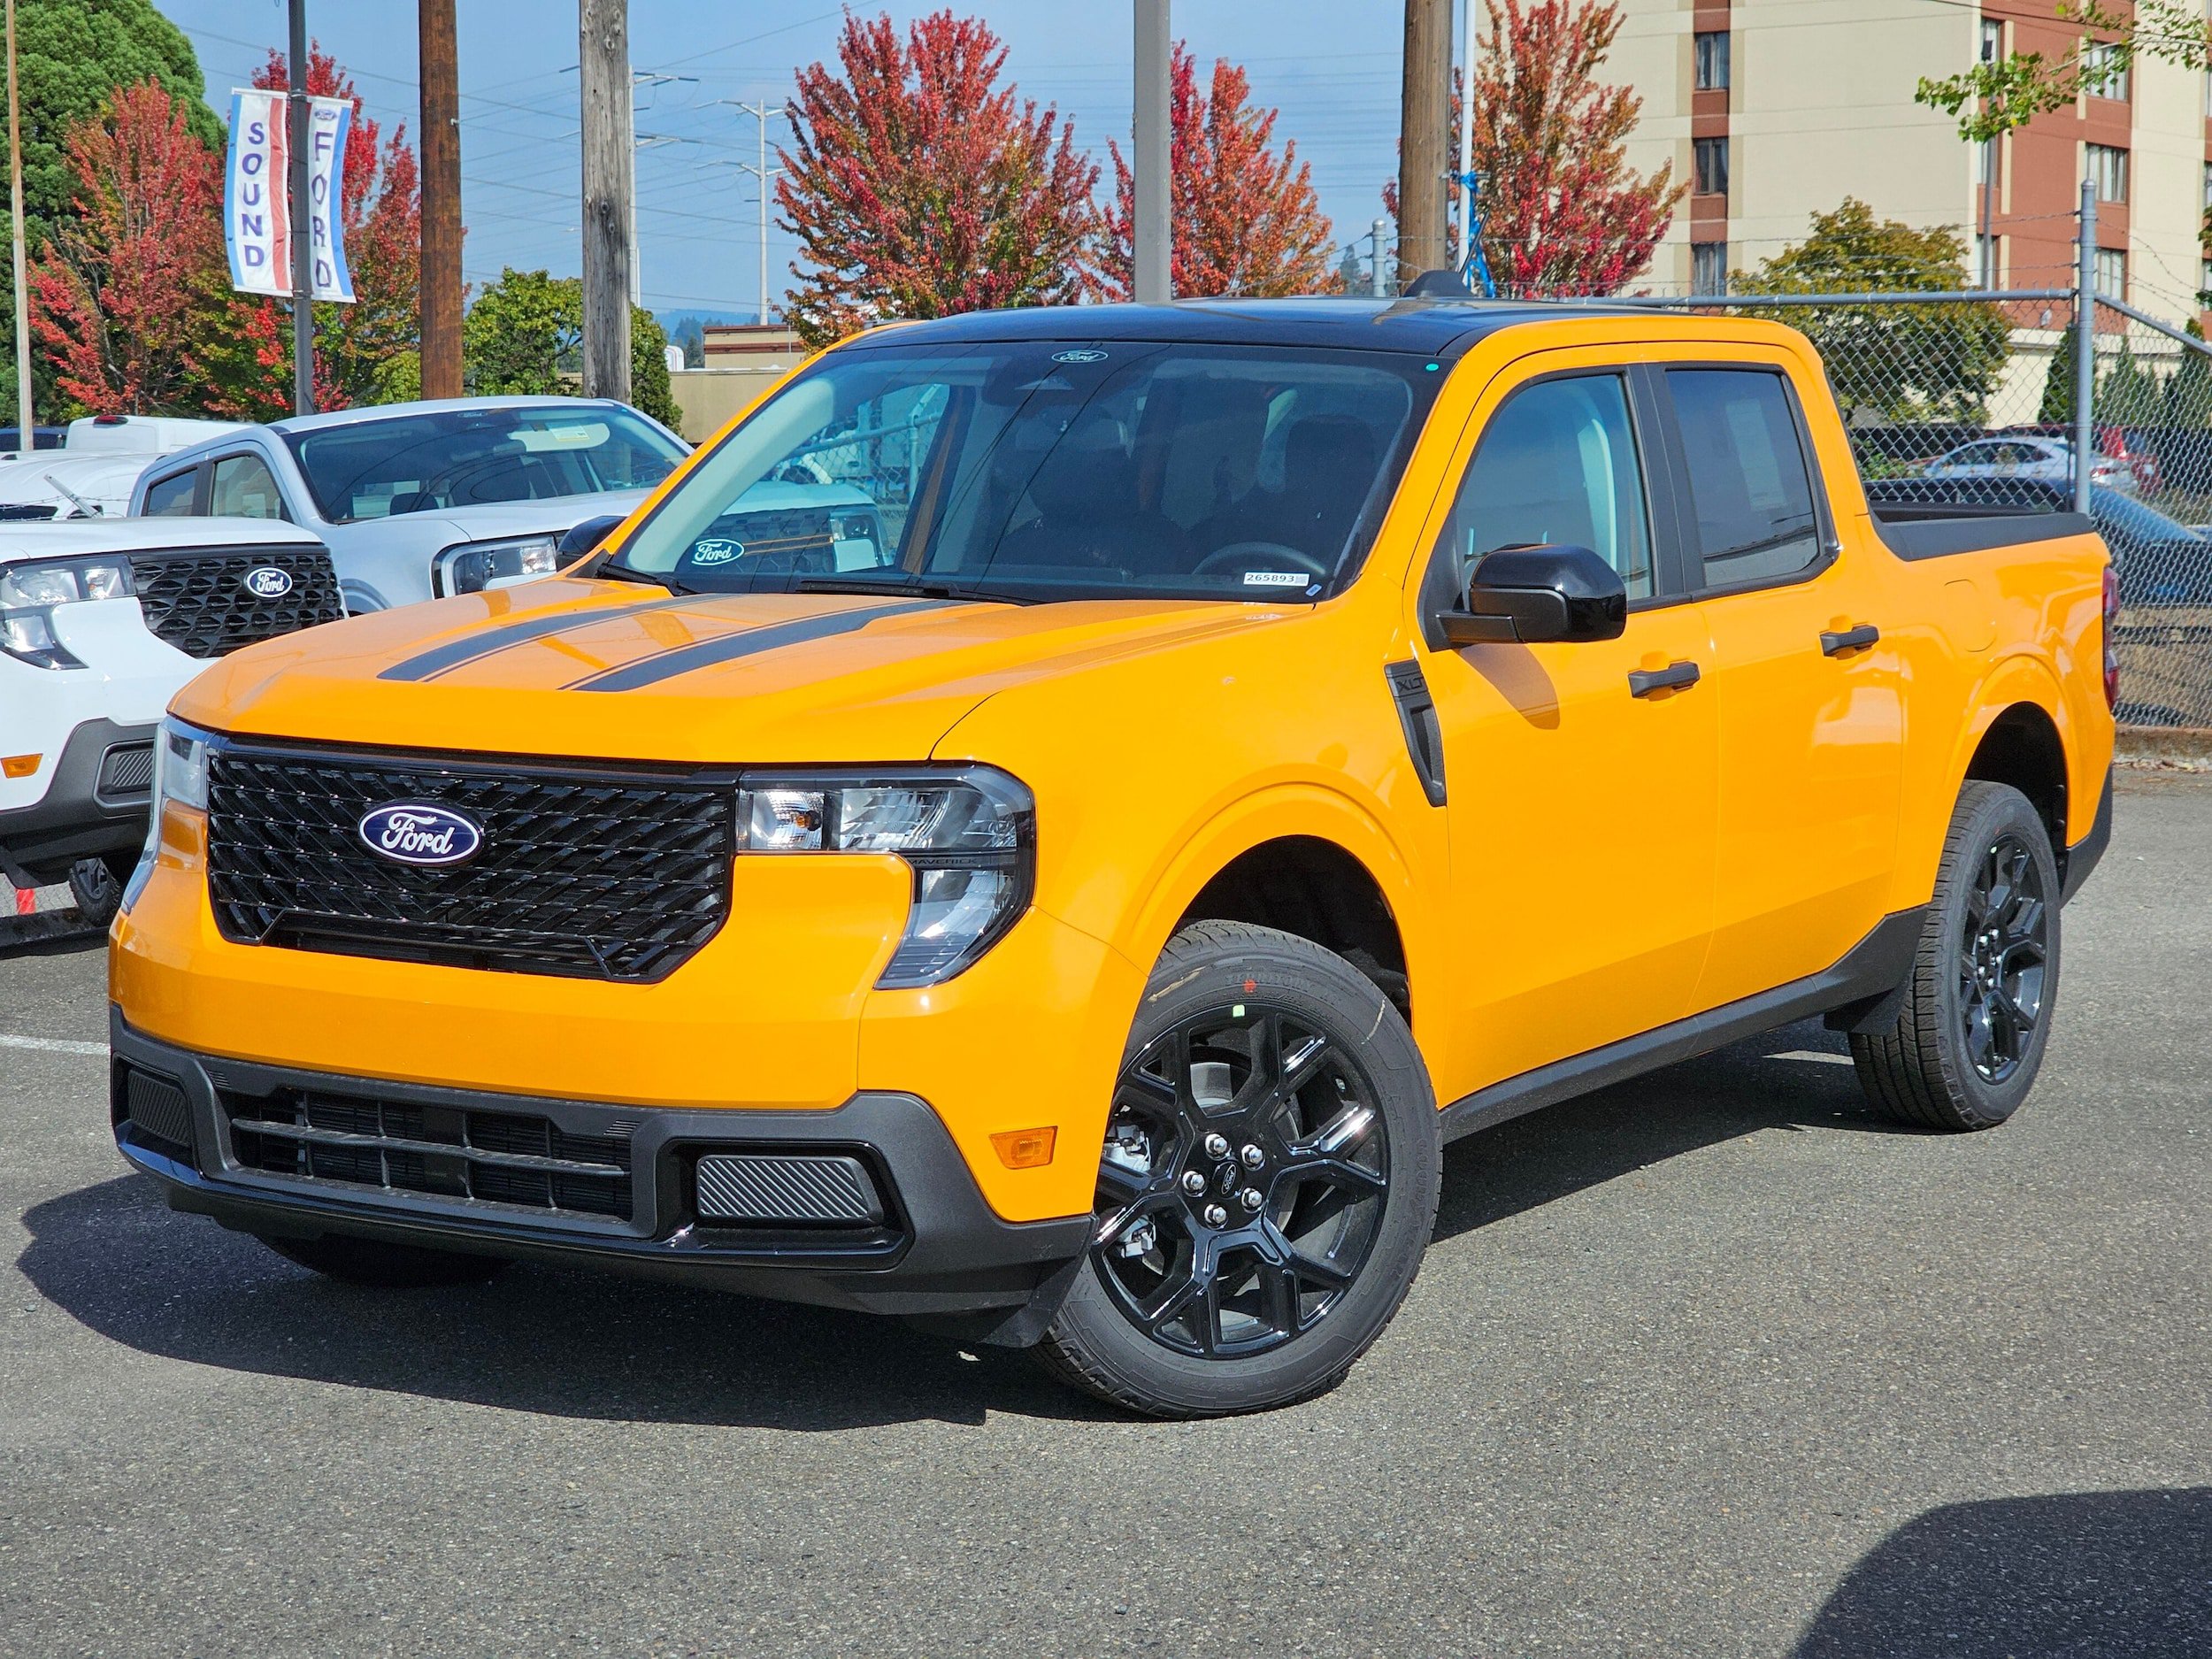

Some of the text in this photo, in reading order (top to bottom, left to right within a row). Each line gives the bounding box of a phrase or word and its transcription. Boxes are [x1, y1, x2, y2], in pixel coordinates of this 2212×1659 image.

[242, 122, 265, 267] SOUND
[311, 131, 334, 288] FORD
[695, 542, 733, 562] Ford
[257, 572, 285, 593] Ford
[1246, 573, 1295, 583] 265893
[1396, 677, 1424, 693] XLT
[381, 812, 456, 855] Ford
